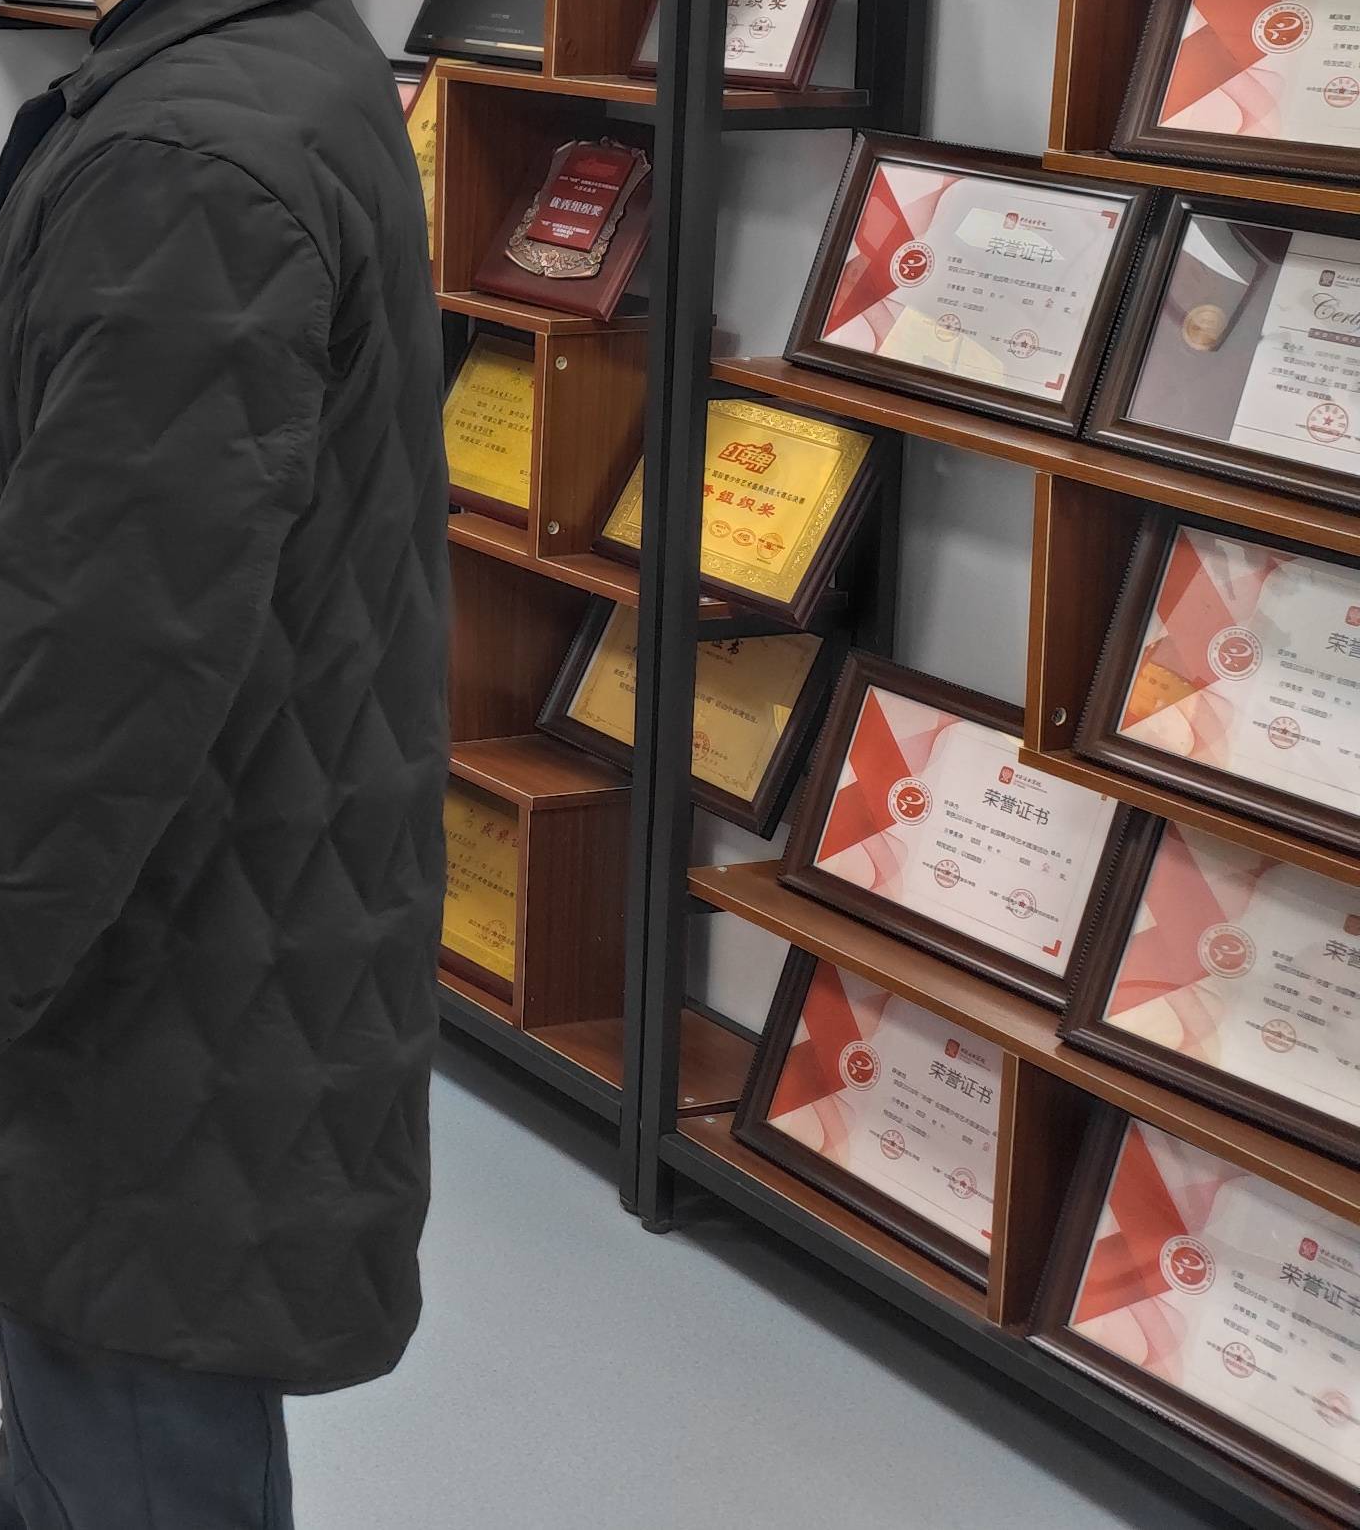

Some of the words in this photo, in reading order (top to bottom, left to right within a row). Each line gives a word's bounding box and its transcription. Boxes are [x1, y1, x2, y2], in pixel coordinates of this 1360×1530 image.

[550, 197, 603, 217] 优秀组织奖
[986, 237, 1056, 265] 荣誉证书
[982, 788, 1051, 826] 荣誉证书
[929, 1060, 994, 1105] 荣誉证书
